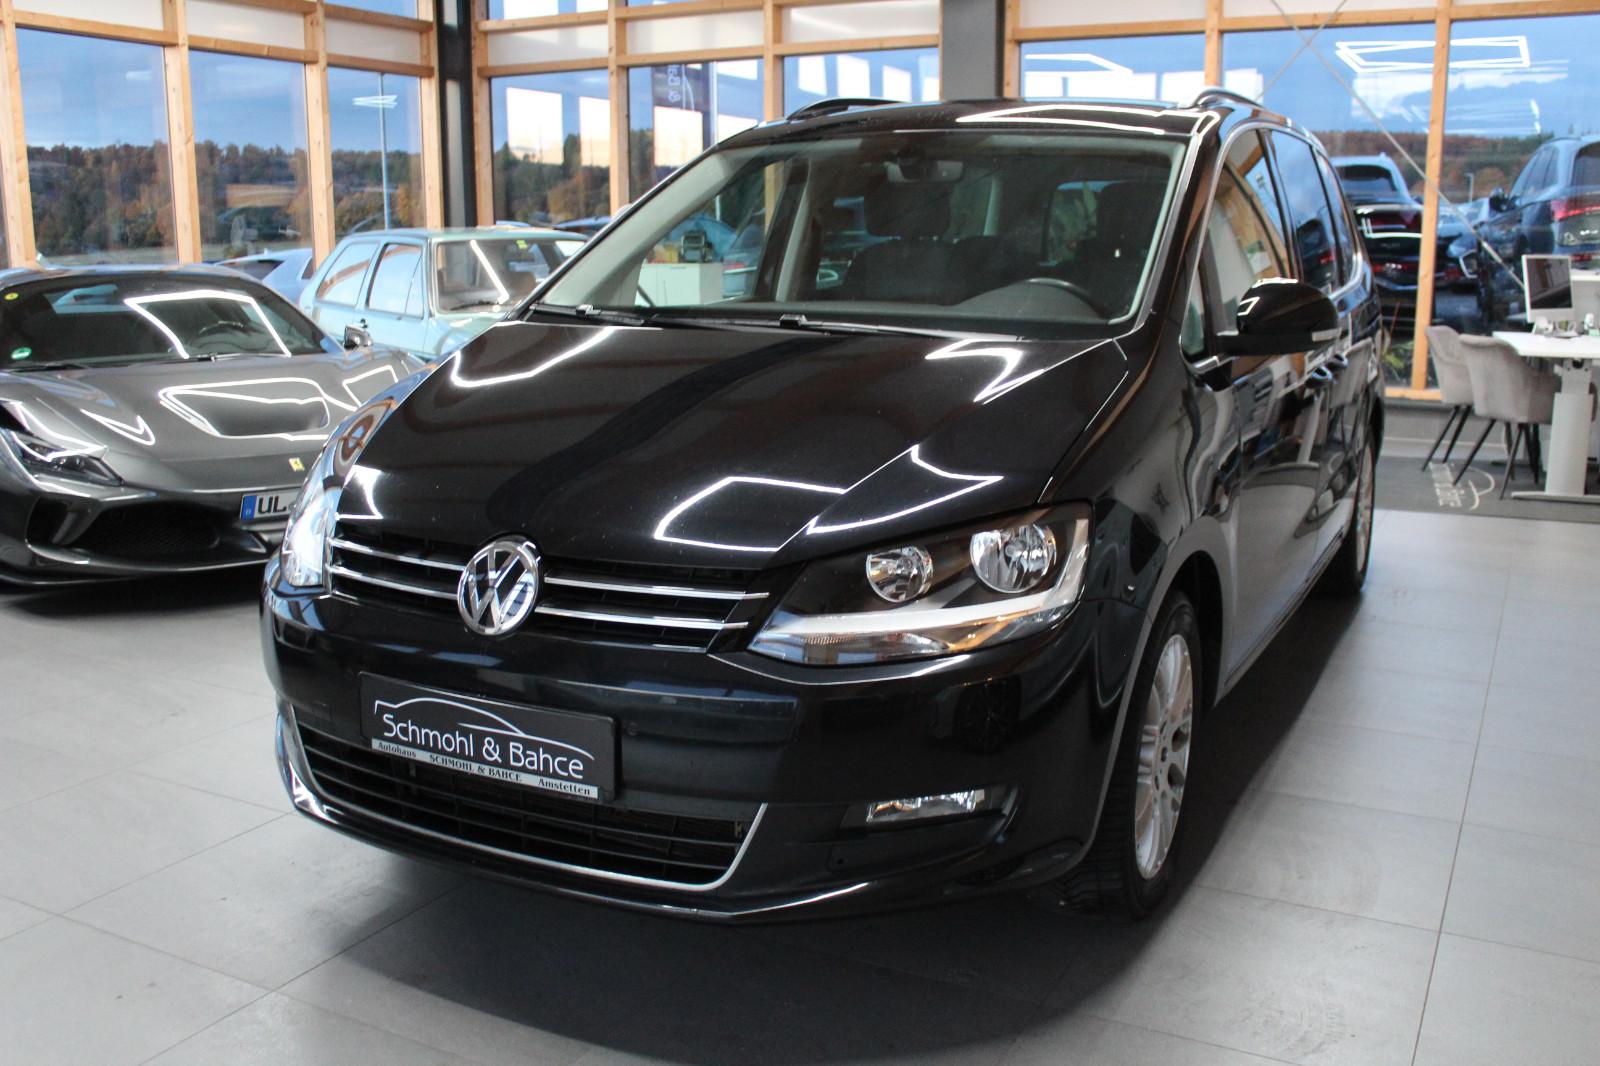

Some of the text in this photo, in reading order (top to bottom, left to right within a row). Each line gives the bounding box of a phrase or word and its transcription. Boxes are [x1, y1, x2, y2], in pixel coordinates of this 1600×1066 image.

[257, 495, 288, 515] UL
[458, 541, 540, 635] VW
[378, 741, 591, 797] Autohaus SCHMOHL & BAHCE Amstetten
[382, 713, 585, 780] Schmohl & Bahce
